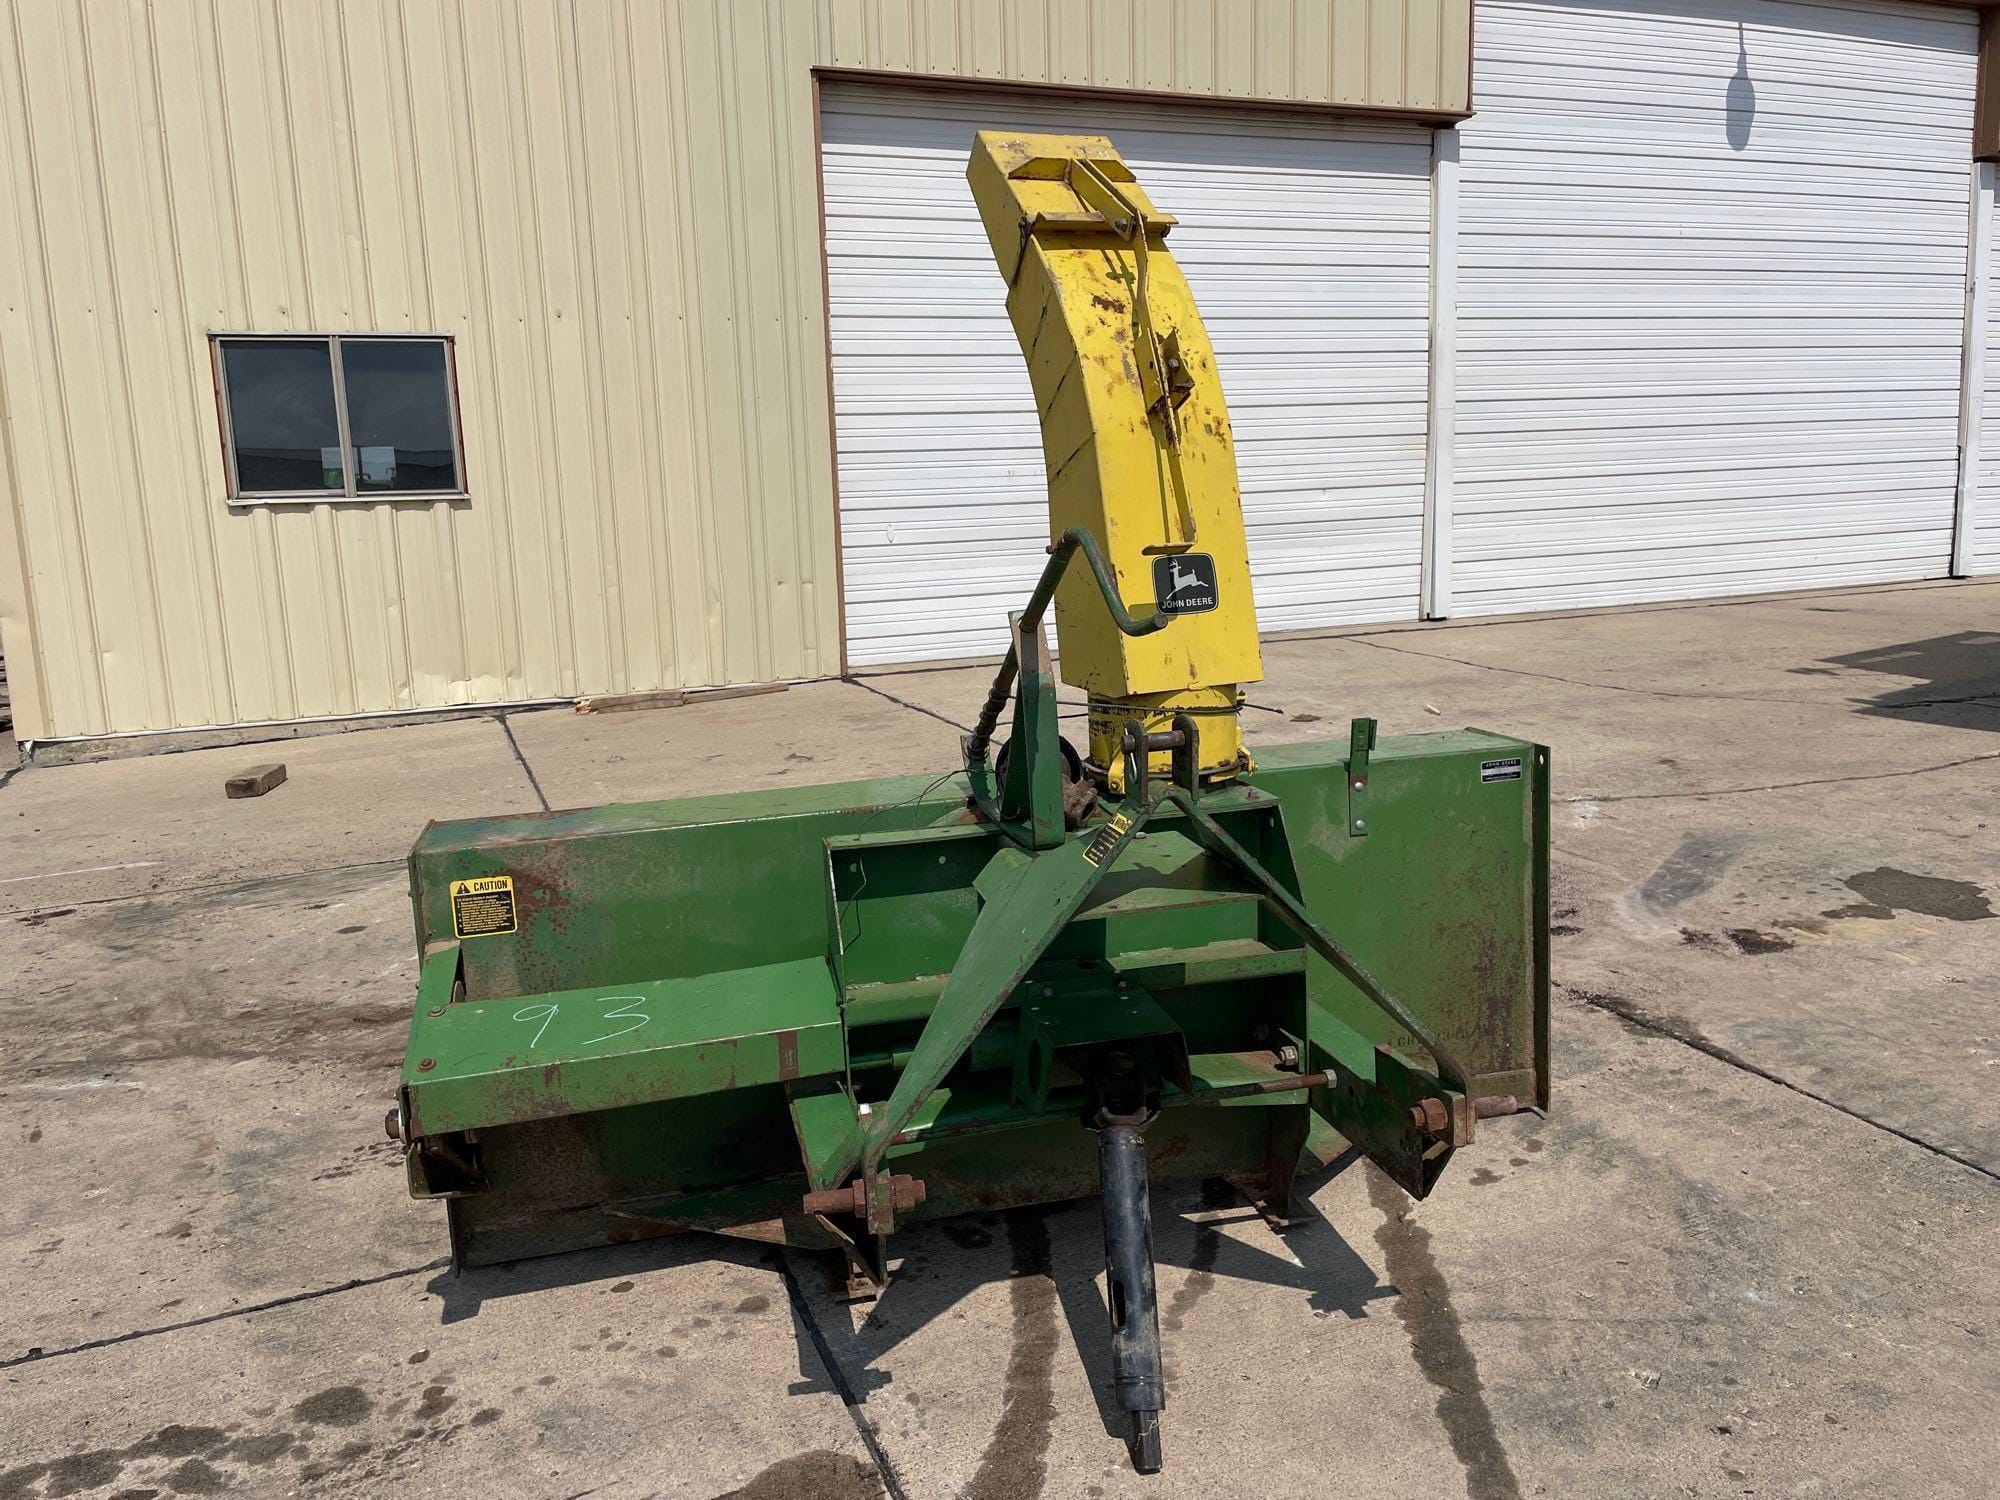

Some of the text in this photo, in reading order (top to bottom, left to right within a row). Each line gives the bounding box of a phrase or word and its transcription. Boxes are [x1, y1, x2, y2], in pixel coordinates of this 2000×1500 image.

[1161, 596, 1214, 609] JOHN DEERE
[473, 879, 508, 892] CAUTION
